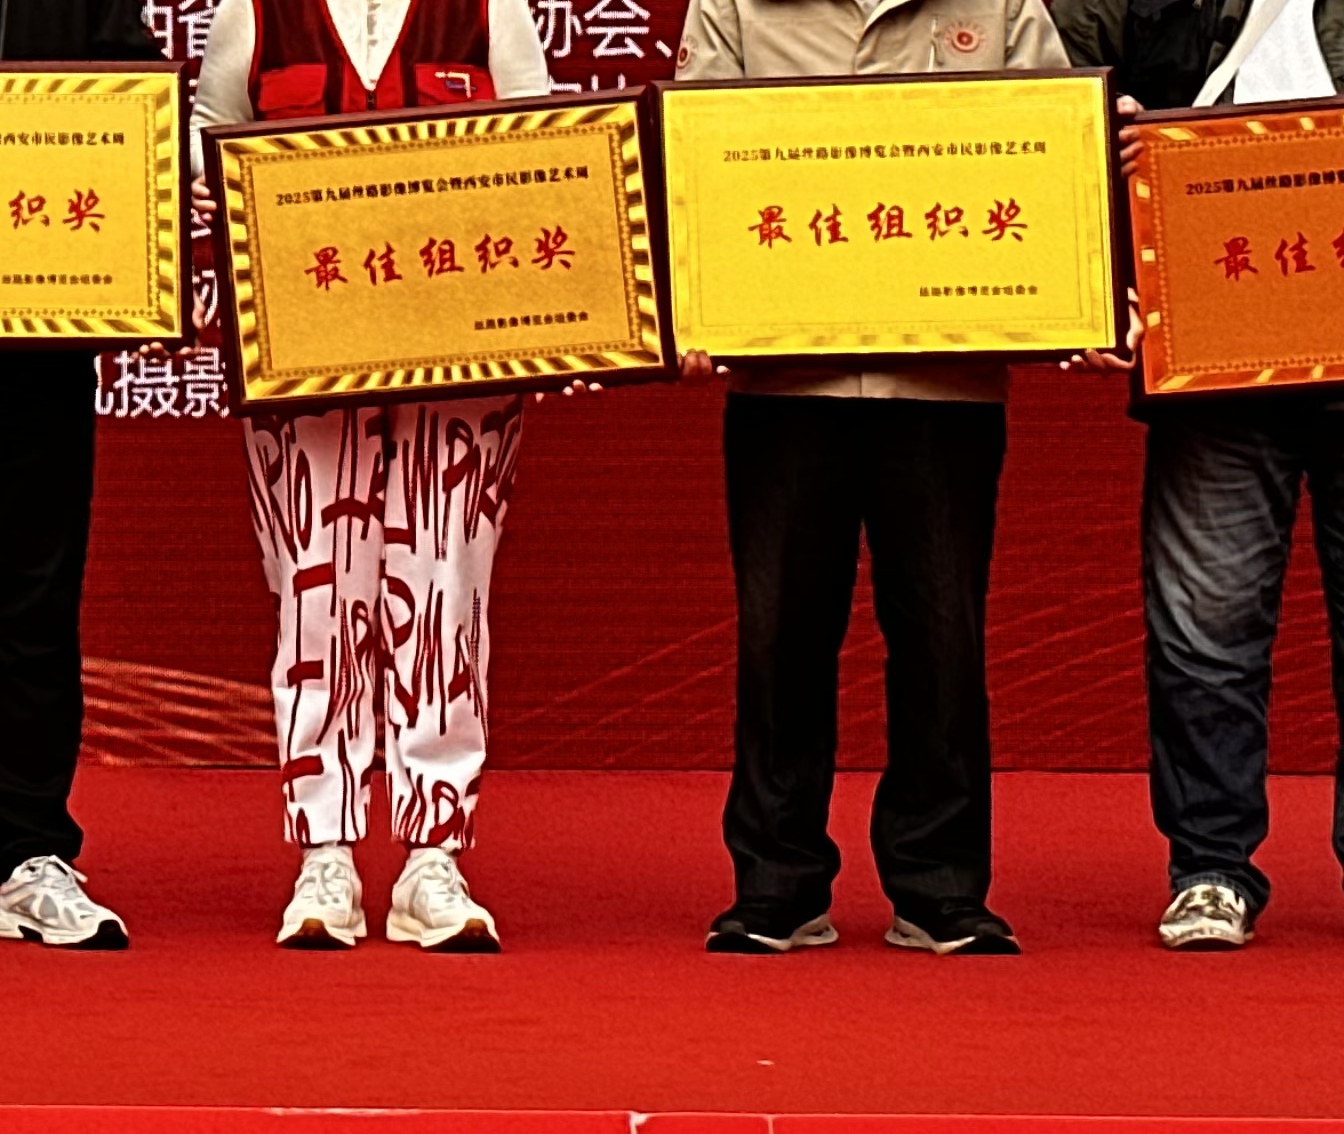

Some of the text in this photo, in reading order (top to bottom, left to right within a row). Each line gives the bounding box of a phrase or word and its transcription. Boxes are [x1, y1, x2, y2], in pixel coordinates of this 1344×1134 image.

[748, 198, 1028, 248] 最佳组织奖
[304, 225, 576, 291] 最佳组织奖
[1213, 228, 1344, 282] 最佳
